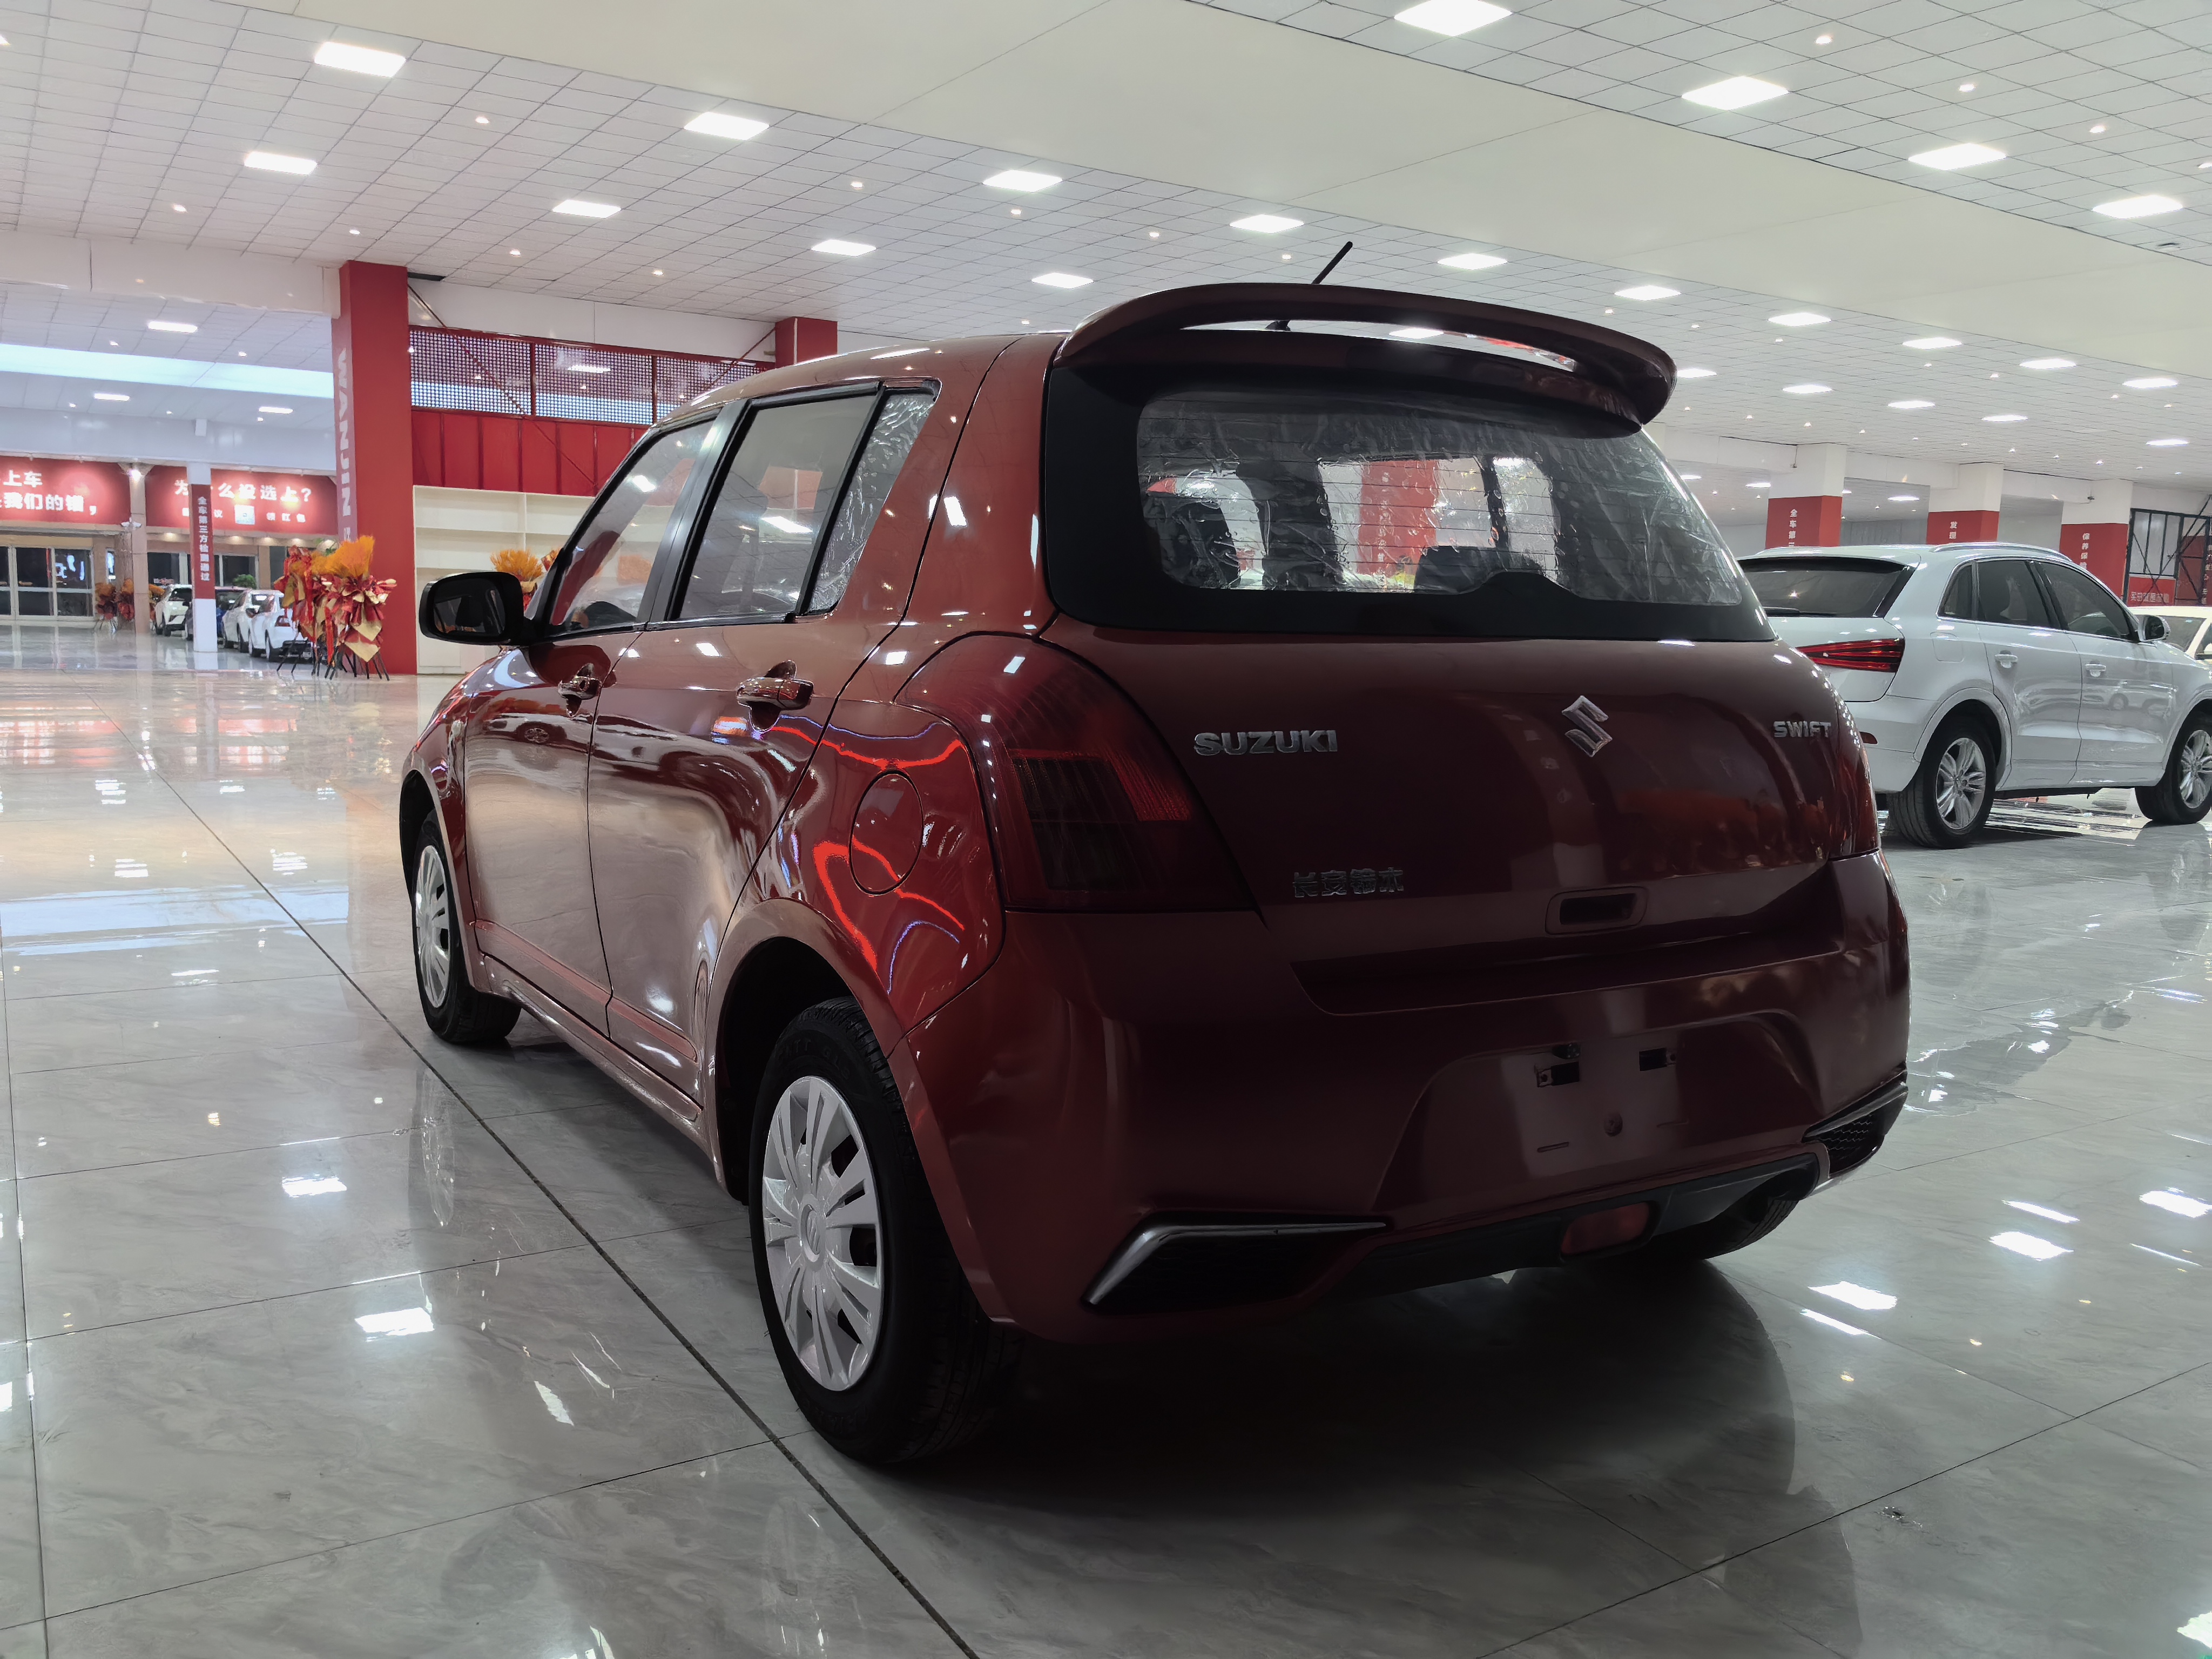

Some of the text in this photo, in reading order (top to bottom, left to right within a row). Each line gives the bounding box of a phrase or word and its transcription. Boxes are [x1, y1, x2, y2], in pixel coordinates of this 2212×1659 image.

[174, 479, 312, 502] 为么没选上？
[0, 491, 97, 516] 我们的错，
[1773, 720, 1832, 738] SWIFT
[1193, 730, 1338, 757] SUZUKI
